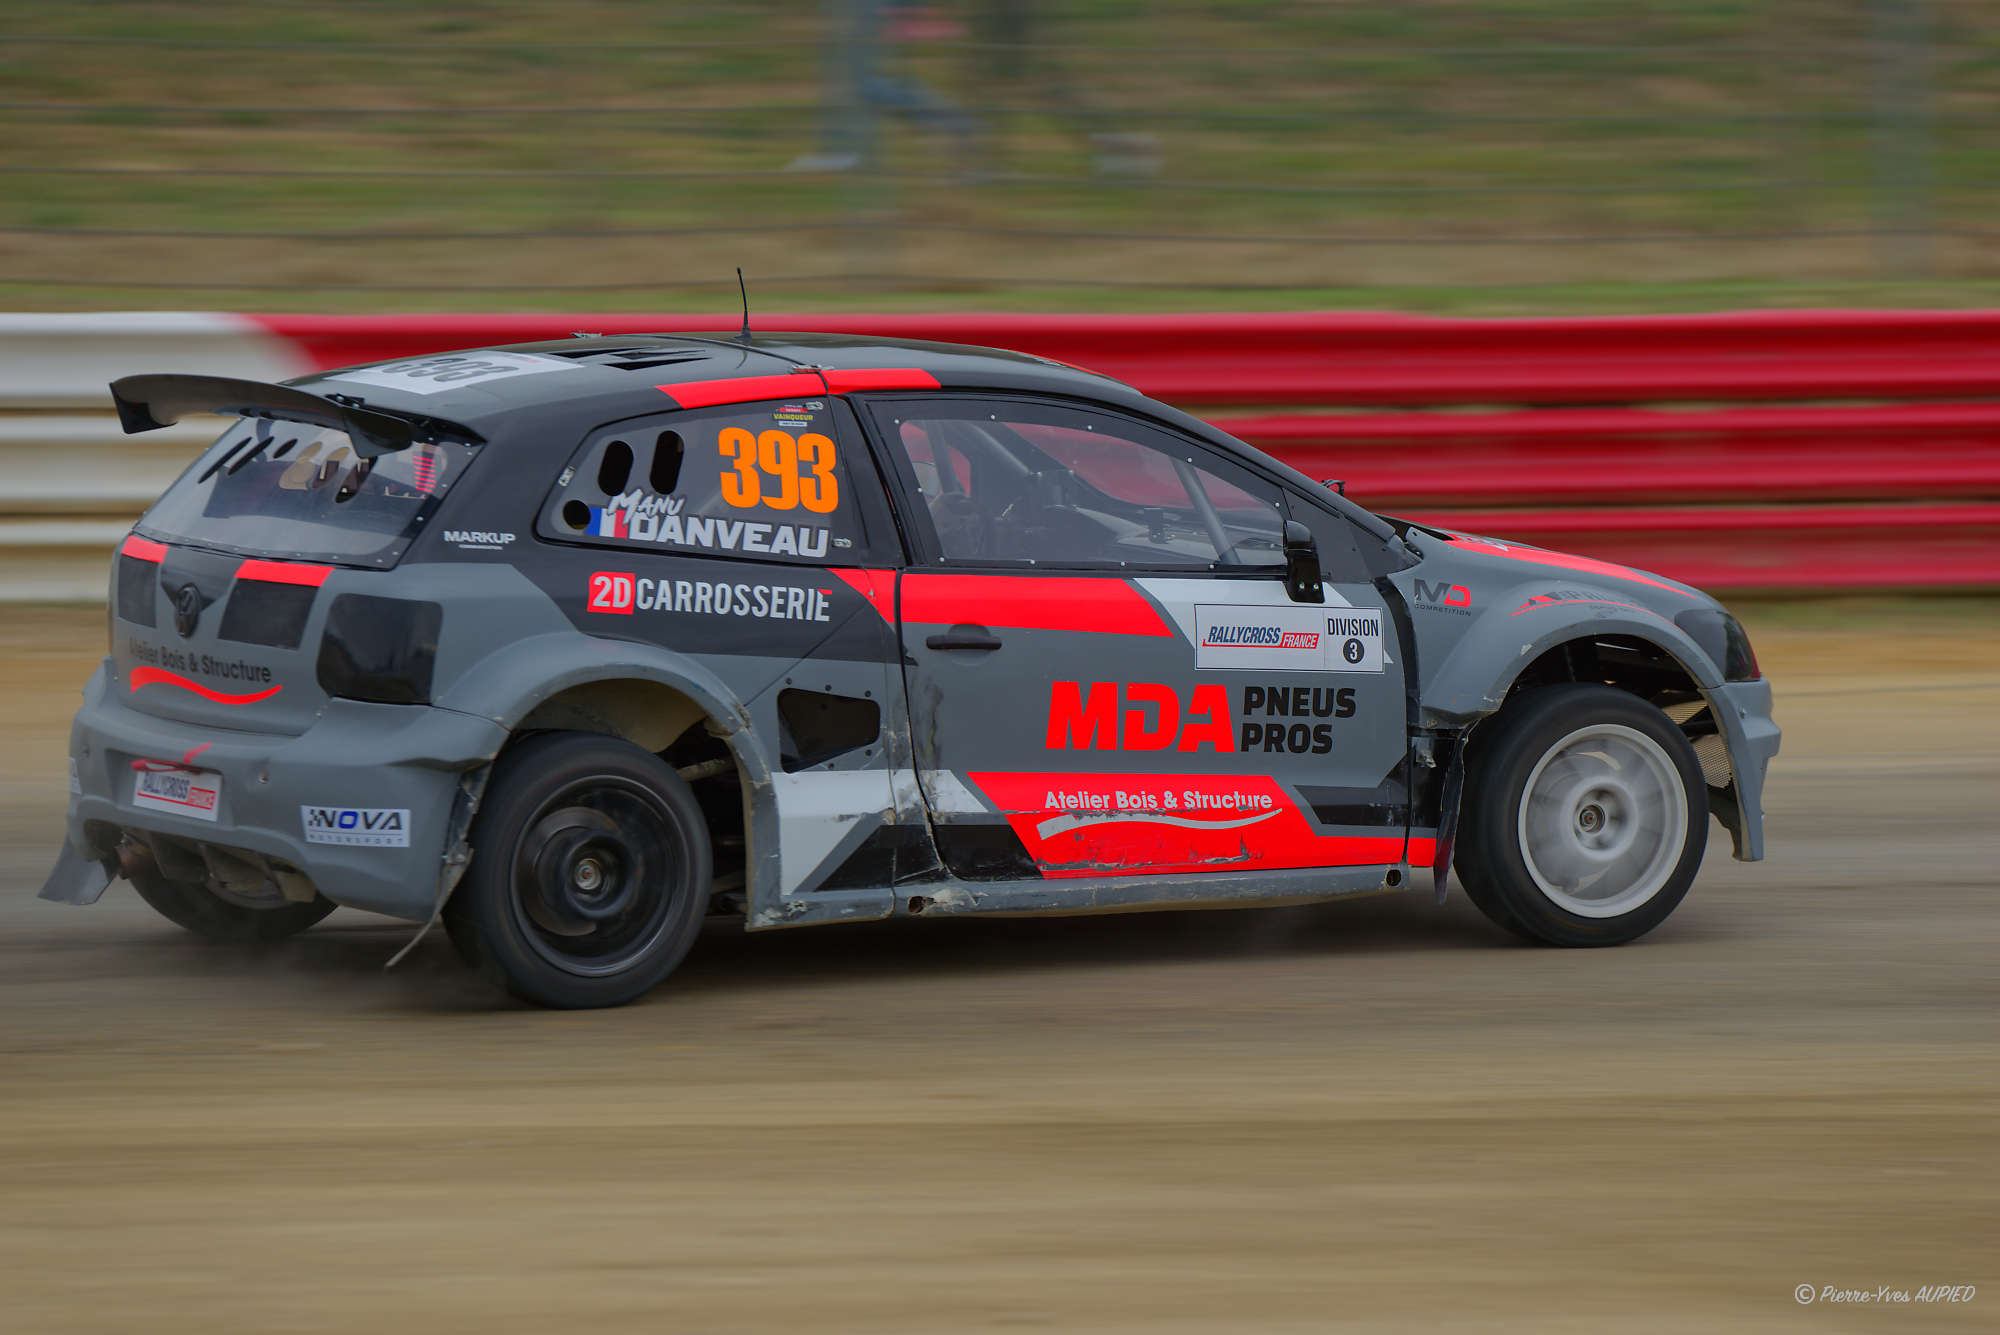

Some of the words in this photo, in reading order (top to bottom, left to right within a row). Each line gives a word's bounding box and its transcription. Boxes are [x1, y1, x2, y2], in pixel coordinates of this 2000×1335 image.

[718, 427, 838, 514] 393
[443, 530, 516, 544] MARKUP
[628, 511, 828, 558] DANVEAU
[592, 576, 631, 608] 2D
[635, 578, 830, 622] CARROSSERIE
[1414, 603, 1472, 617] COMPETITION
[1208, 626, 1281, 644] RALLYCROSS
[1282, 634, 1319, 648] FRANCE
[1327, 618, 1379, 637] DIVISION
[160, 645, 186, 671] Bois
[201, 653, 272, 683] Structure
[1349, 642, 1358, 660] 3
[1243, 686, 1357, 718] PNEUS
[1045, 681, 1236, 753] MDA
[1240, 723, 1334, 755] PROS
[1045, 791, 1110, 809] Atelier
[1115, 791, 1158, 809] Bois
[1163, 790, 1178, 809] &
[1183, 790, 1273, 811] Structure
[318, 809, 403, 831] NOVA
